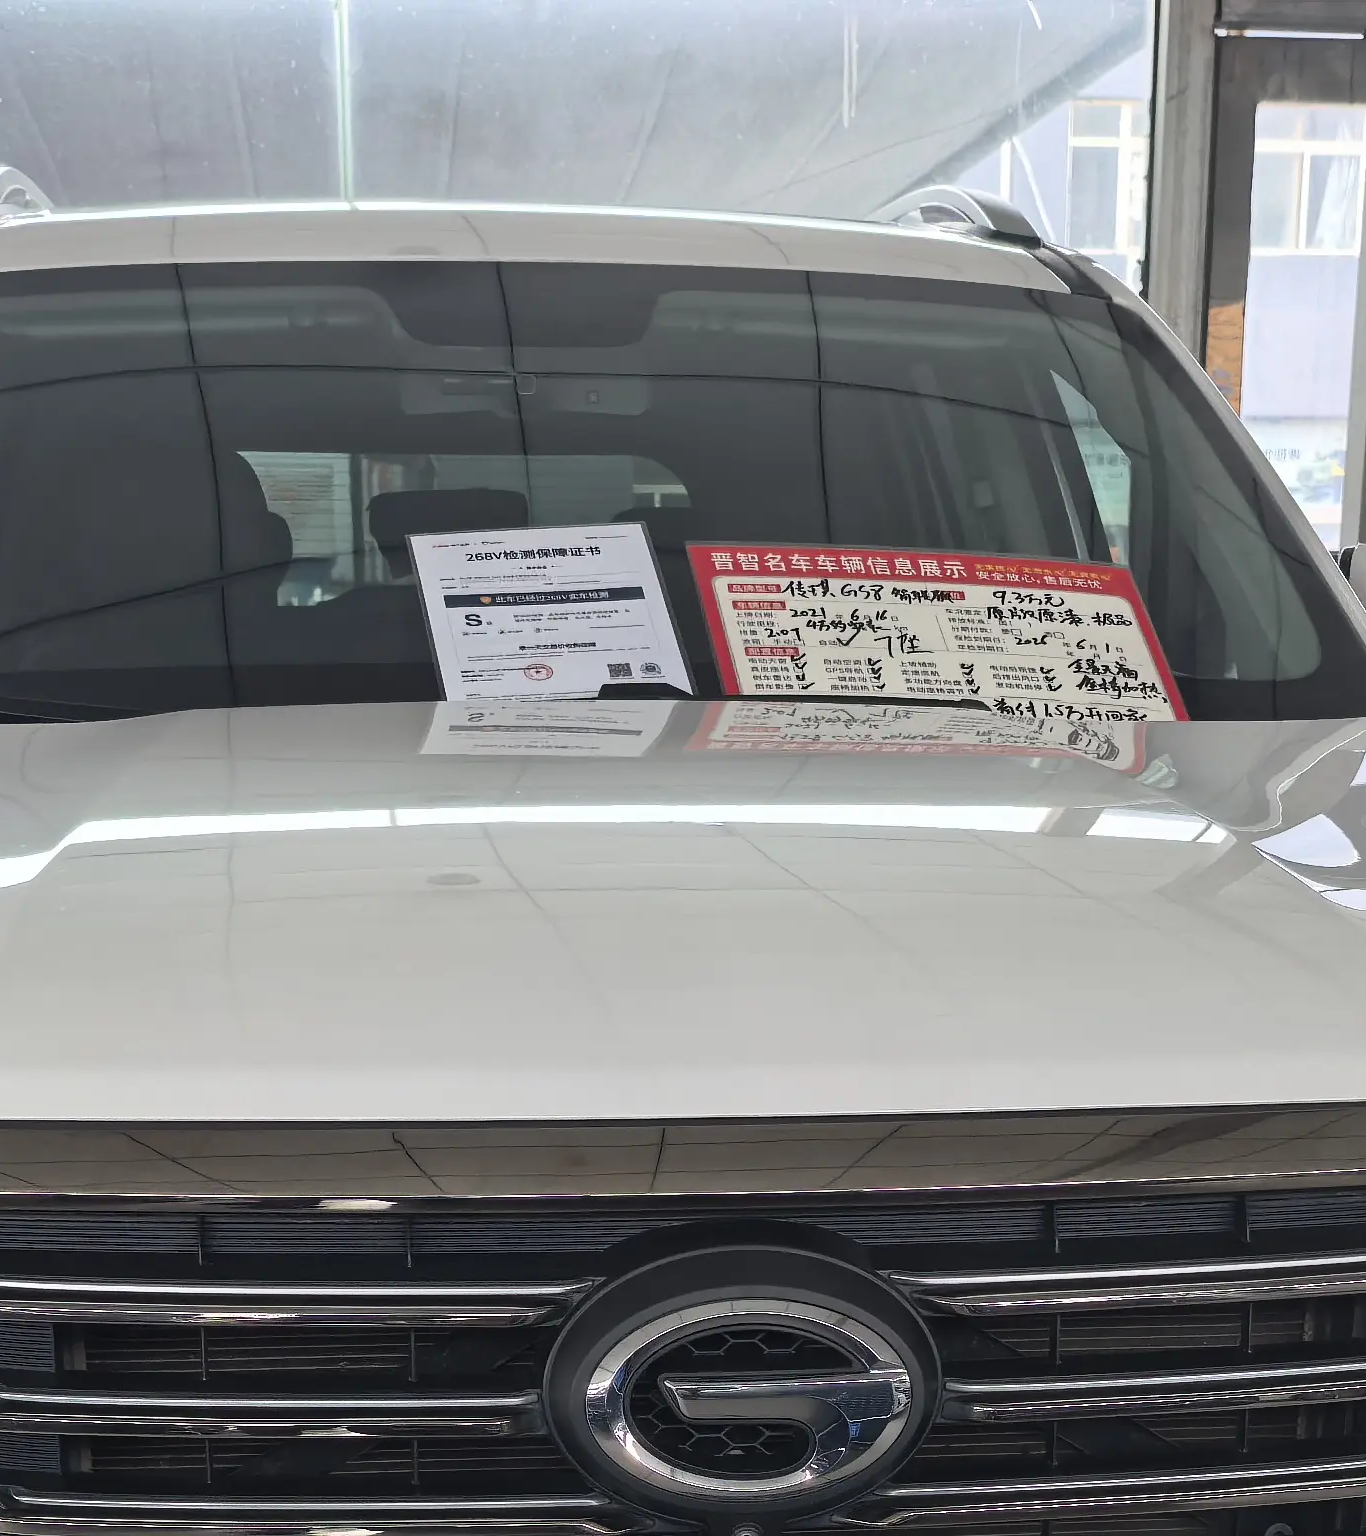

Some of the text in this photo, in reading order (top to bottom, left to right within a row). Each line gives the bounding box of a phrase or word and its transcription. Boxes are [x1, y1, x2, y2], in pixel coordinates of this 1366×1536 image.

[710, 551, 969, 578] 晋智名车车辆信息展示
[840, 583, 885, 601] GS8
[464, 613, 483, 627] S
[788, 606, 827, 619] 2021
